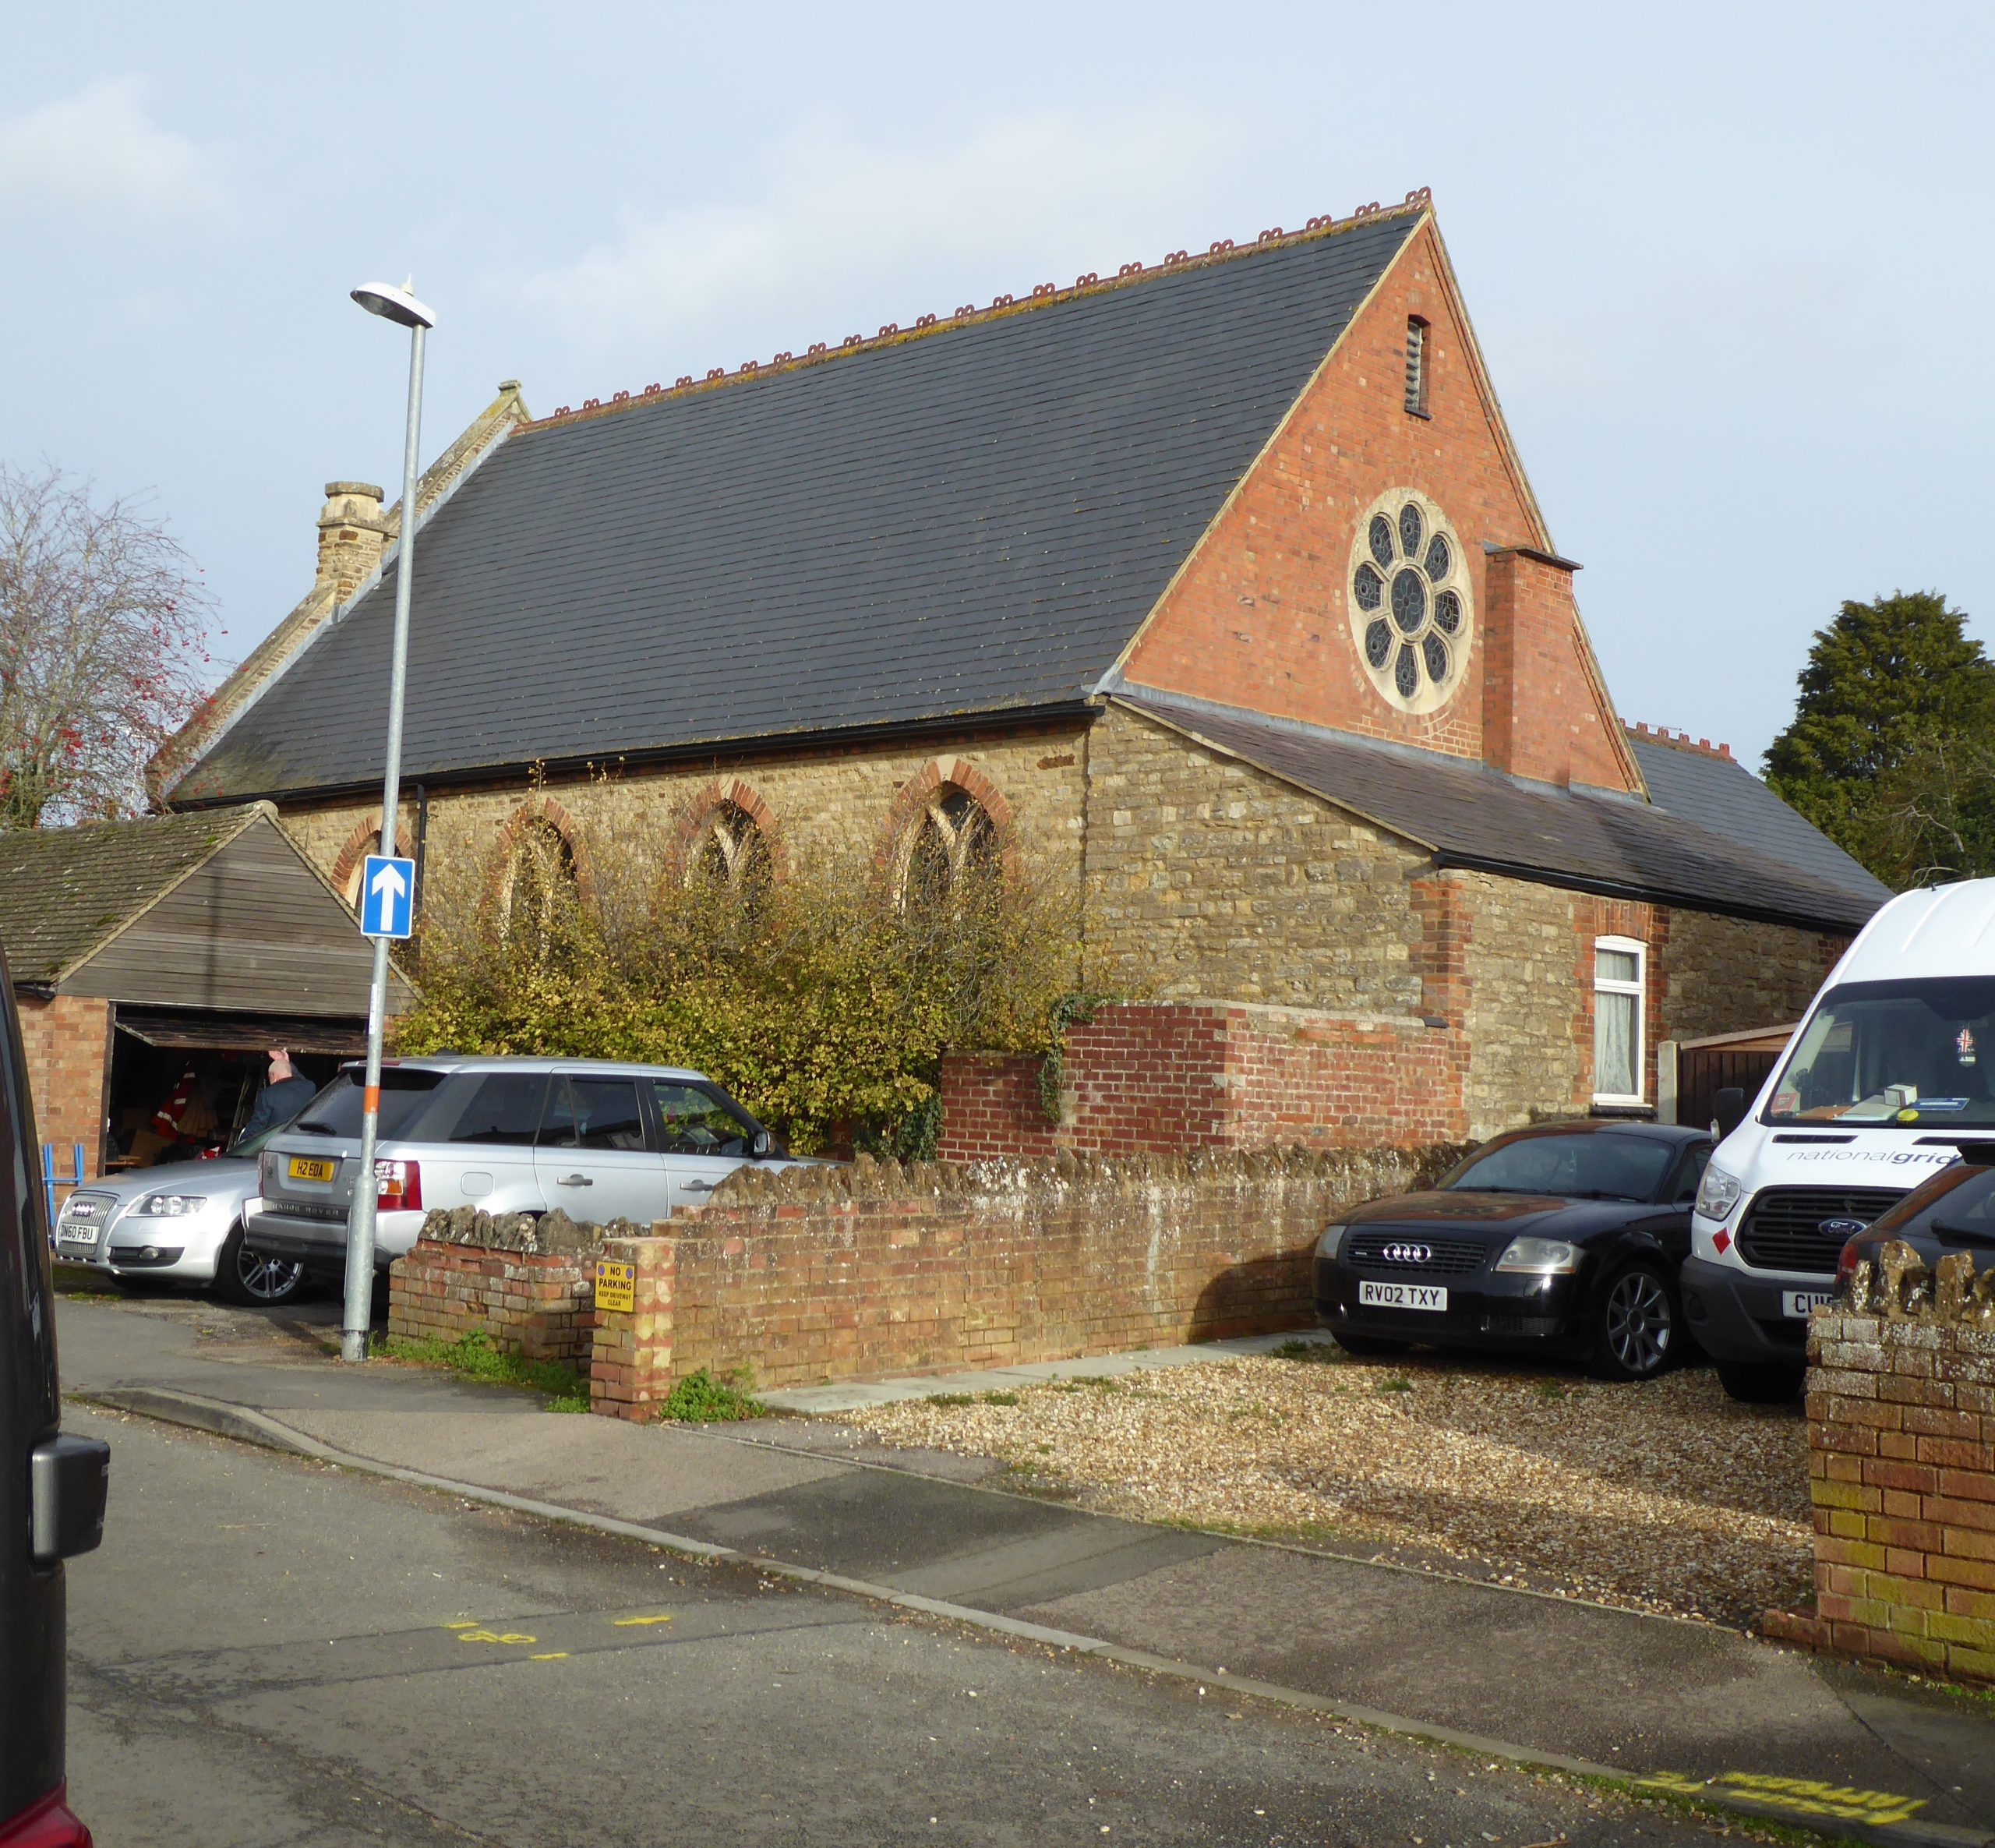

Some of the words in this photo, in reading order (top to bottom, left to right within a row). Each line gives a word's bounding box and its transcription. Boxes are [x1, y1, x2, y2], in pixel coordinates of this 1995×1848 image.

[297, 1161, 308, 1175] H2
[77, 1227, 93, 1240] FBU
[1828, 1221, 1856, 1235] Ford
[609, 1266, 621, 1276] NO
[598, 1277, 631, 1291] PARKING
[609, 1292, 631, 1301] DRIVEWAY
[1365, 1284, 1404, 1303] RV02
[1407, 1288, 1439, 1306] TXY
